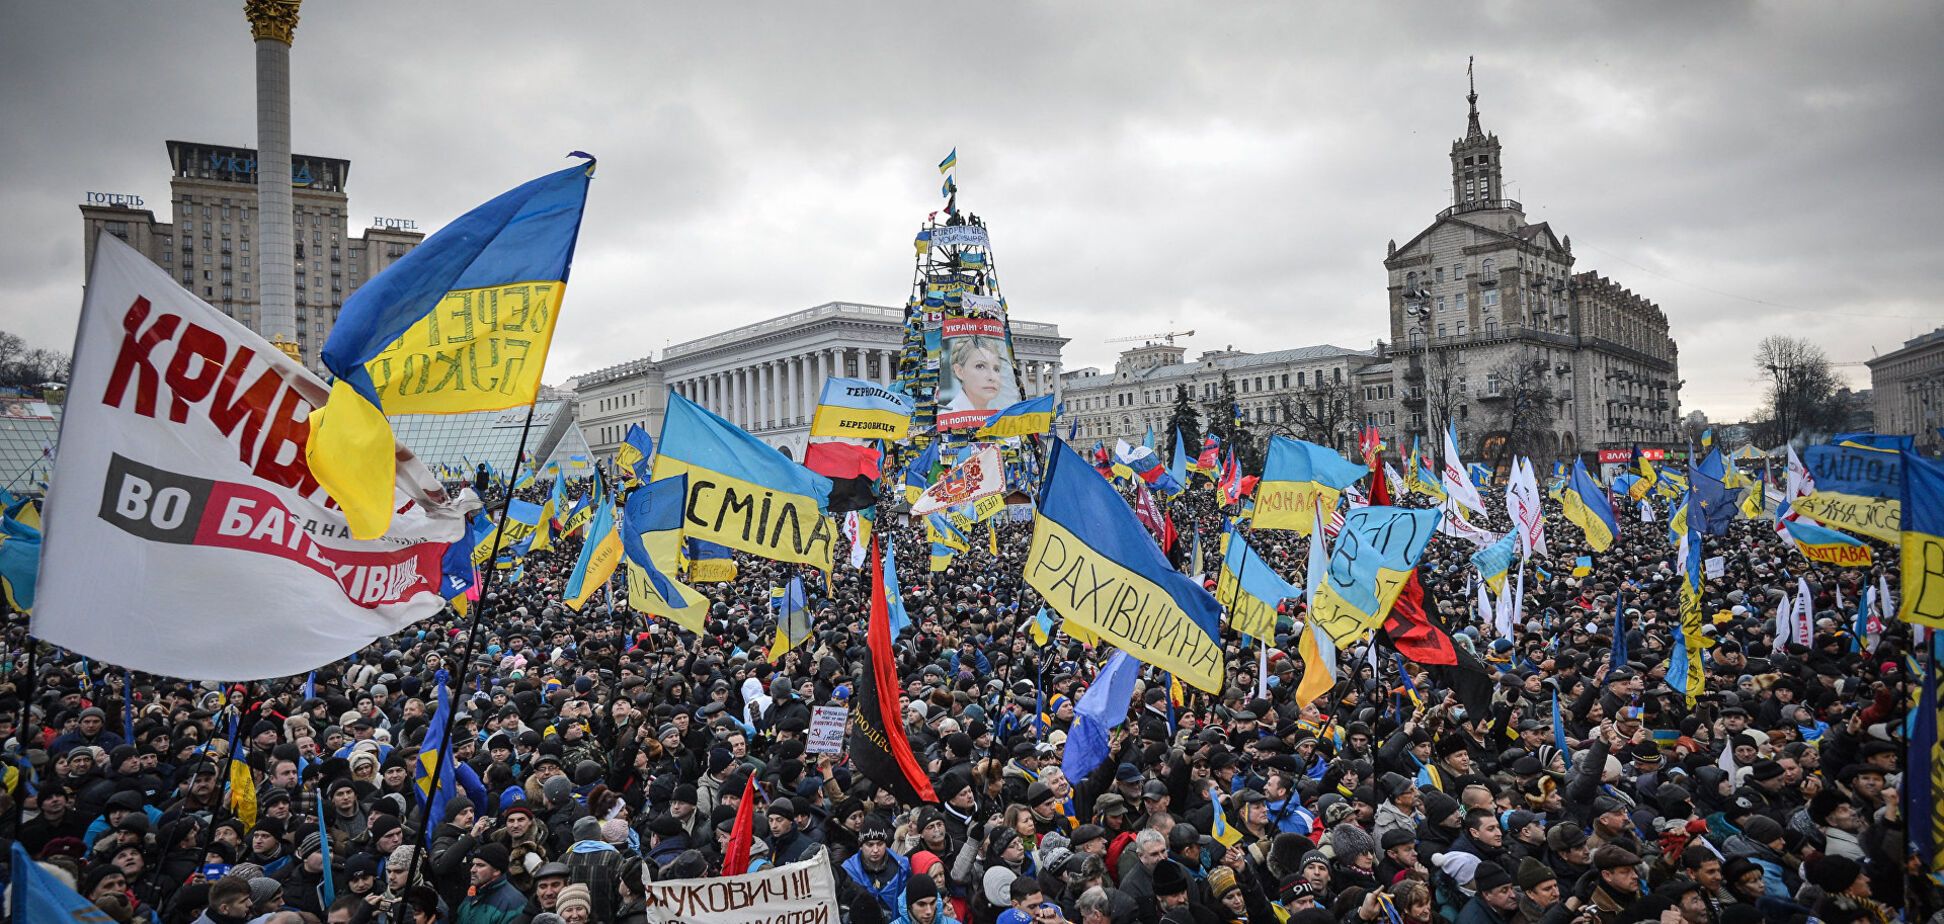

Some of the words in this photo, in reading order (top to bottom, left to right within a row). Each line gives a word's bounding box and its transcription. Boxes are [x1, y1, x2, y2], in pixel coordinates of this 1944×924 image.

[87, 191, 145, 206] ГОТЕЛЬ
[374, 216, 419, 230] HOTEL
[946, 322, 977, 333] УКРАЇНІ
[839, 419, 896, 433] БЕРЕЗОВИЦЯ
[114, 472, 193, 531] ВО
[1293, 882, 1313, 895] 911
